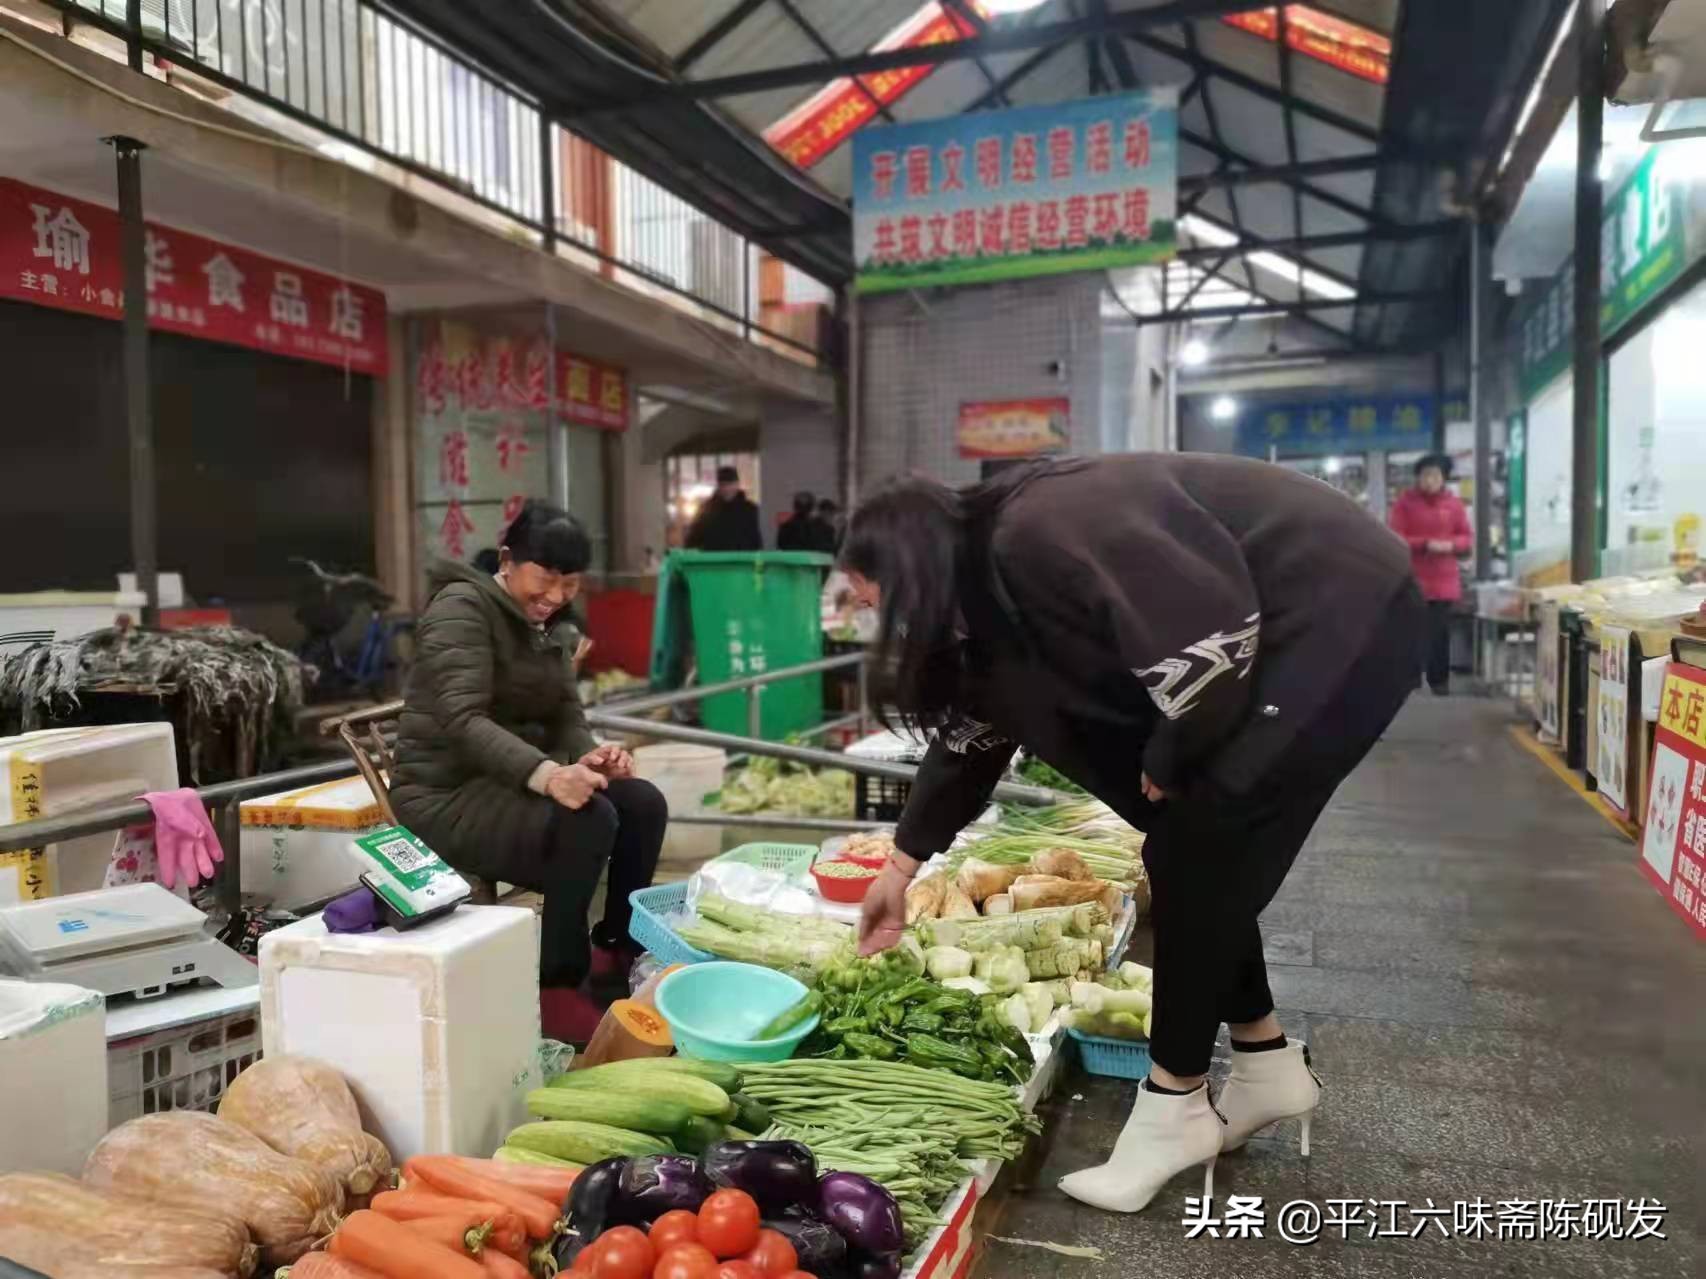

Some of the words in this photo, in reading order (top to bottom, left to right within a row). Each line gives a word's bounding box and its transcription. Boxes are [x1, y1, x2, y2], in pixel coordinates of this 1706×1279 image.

[870, 120, 1151, 198] 开展文明经营活动
[872, 187, 1150, 264] 共筑文明诚信经营环境
